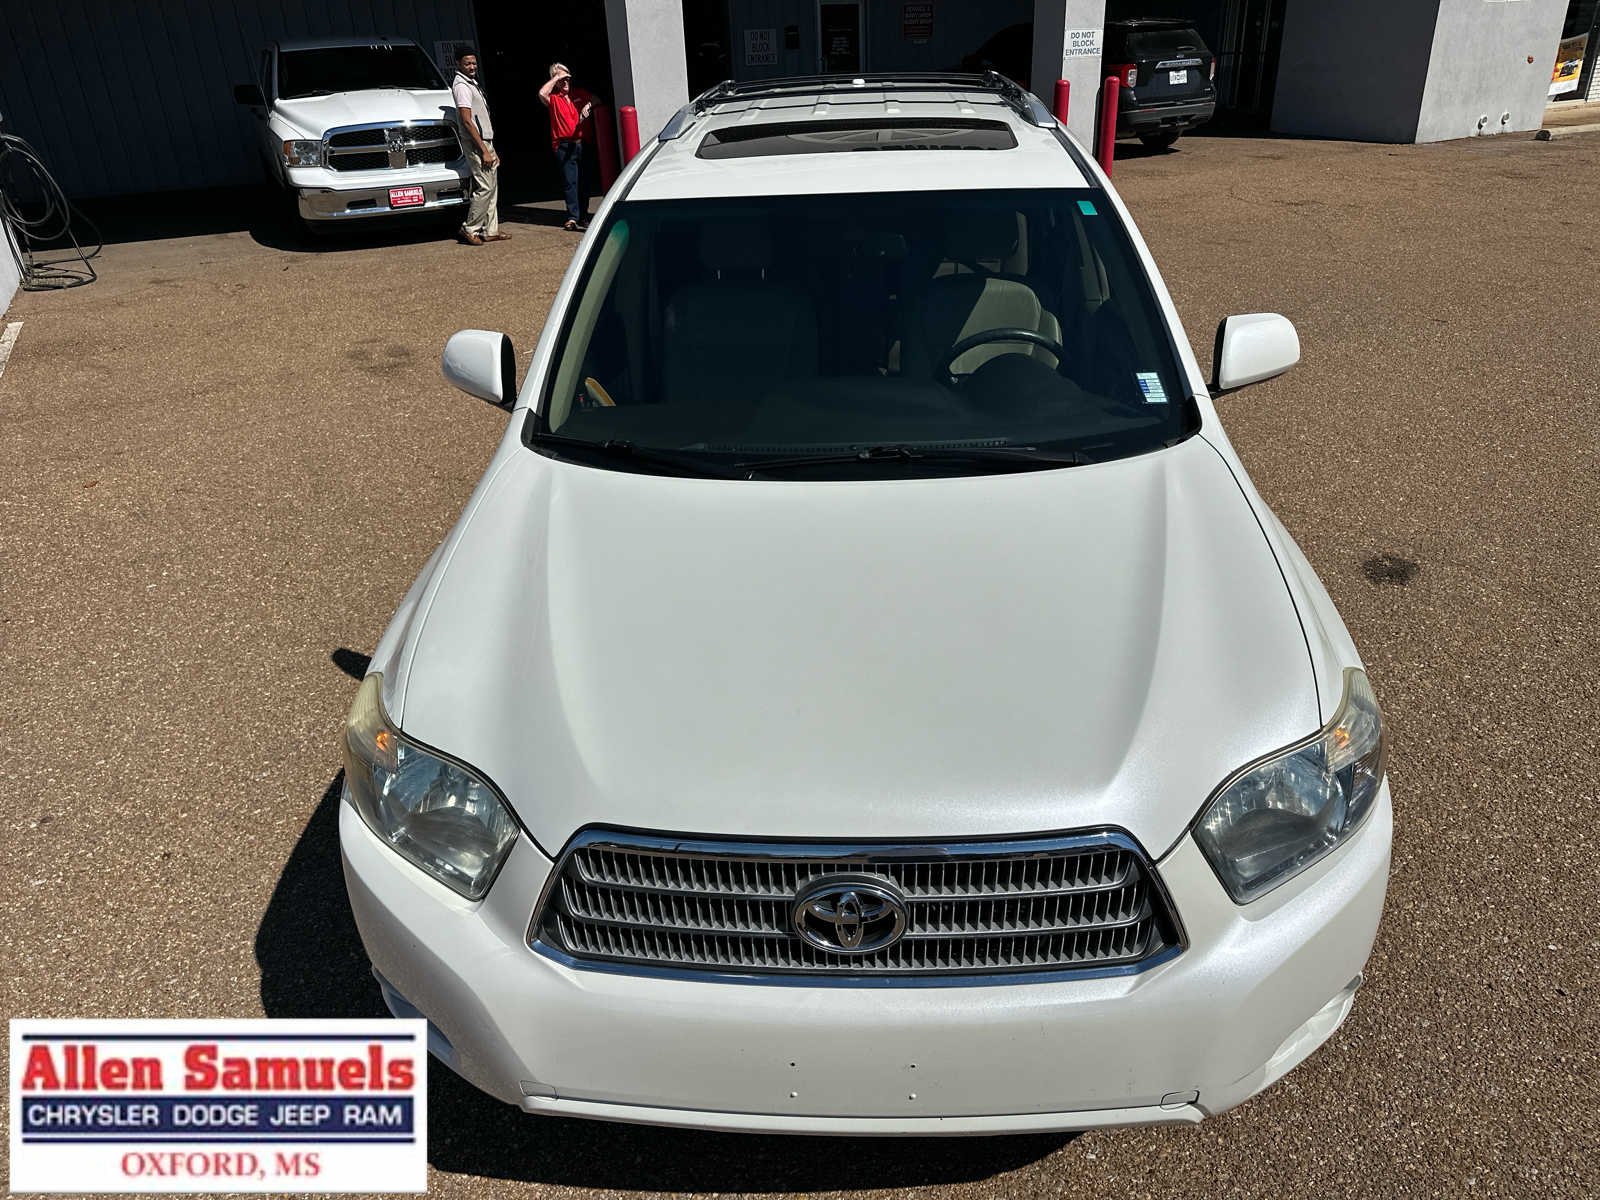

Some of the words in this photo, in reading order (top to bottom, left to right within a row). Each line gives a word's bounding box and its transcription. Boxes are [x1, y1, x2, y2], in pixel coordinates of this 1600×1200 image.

[1081, 31, 1095, 39] NOT
[1072, 40, 1095, 48] BLOCK
[1065, 47, 1101, 56] ENTRANCE
